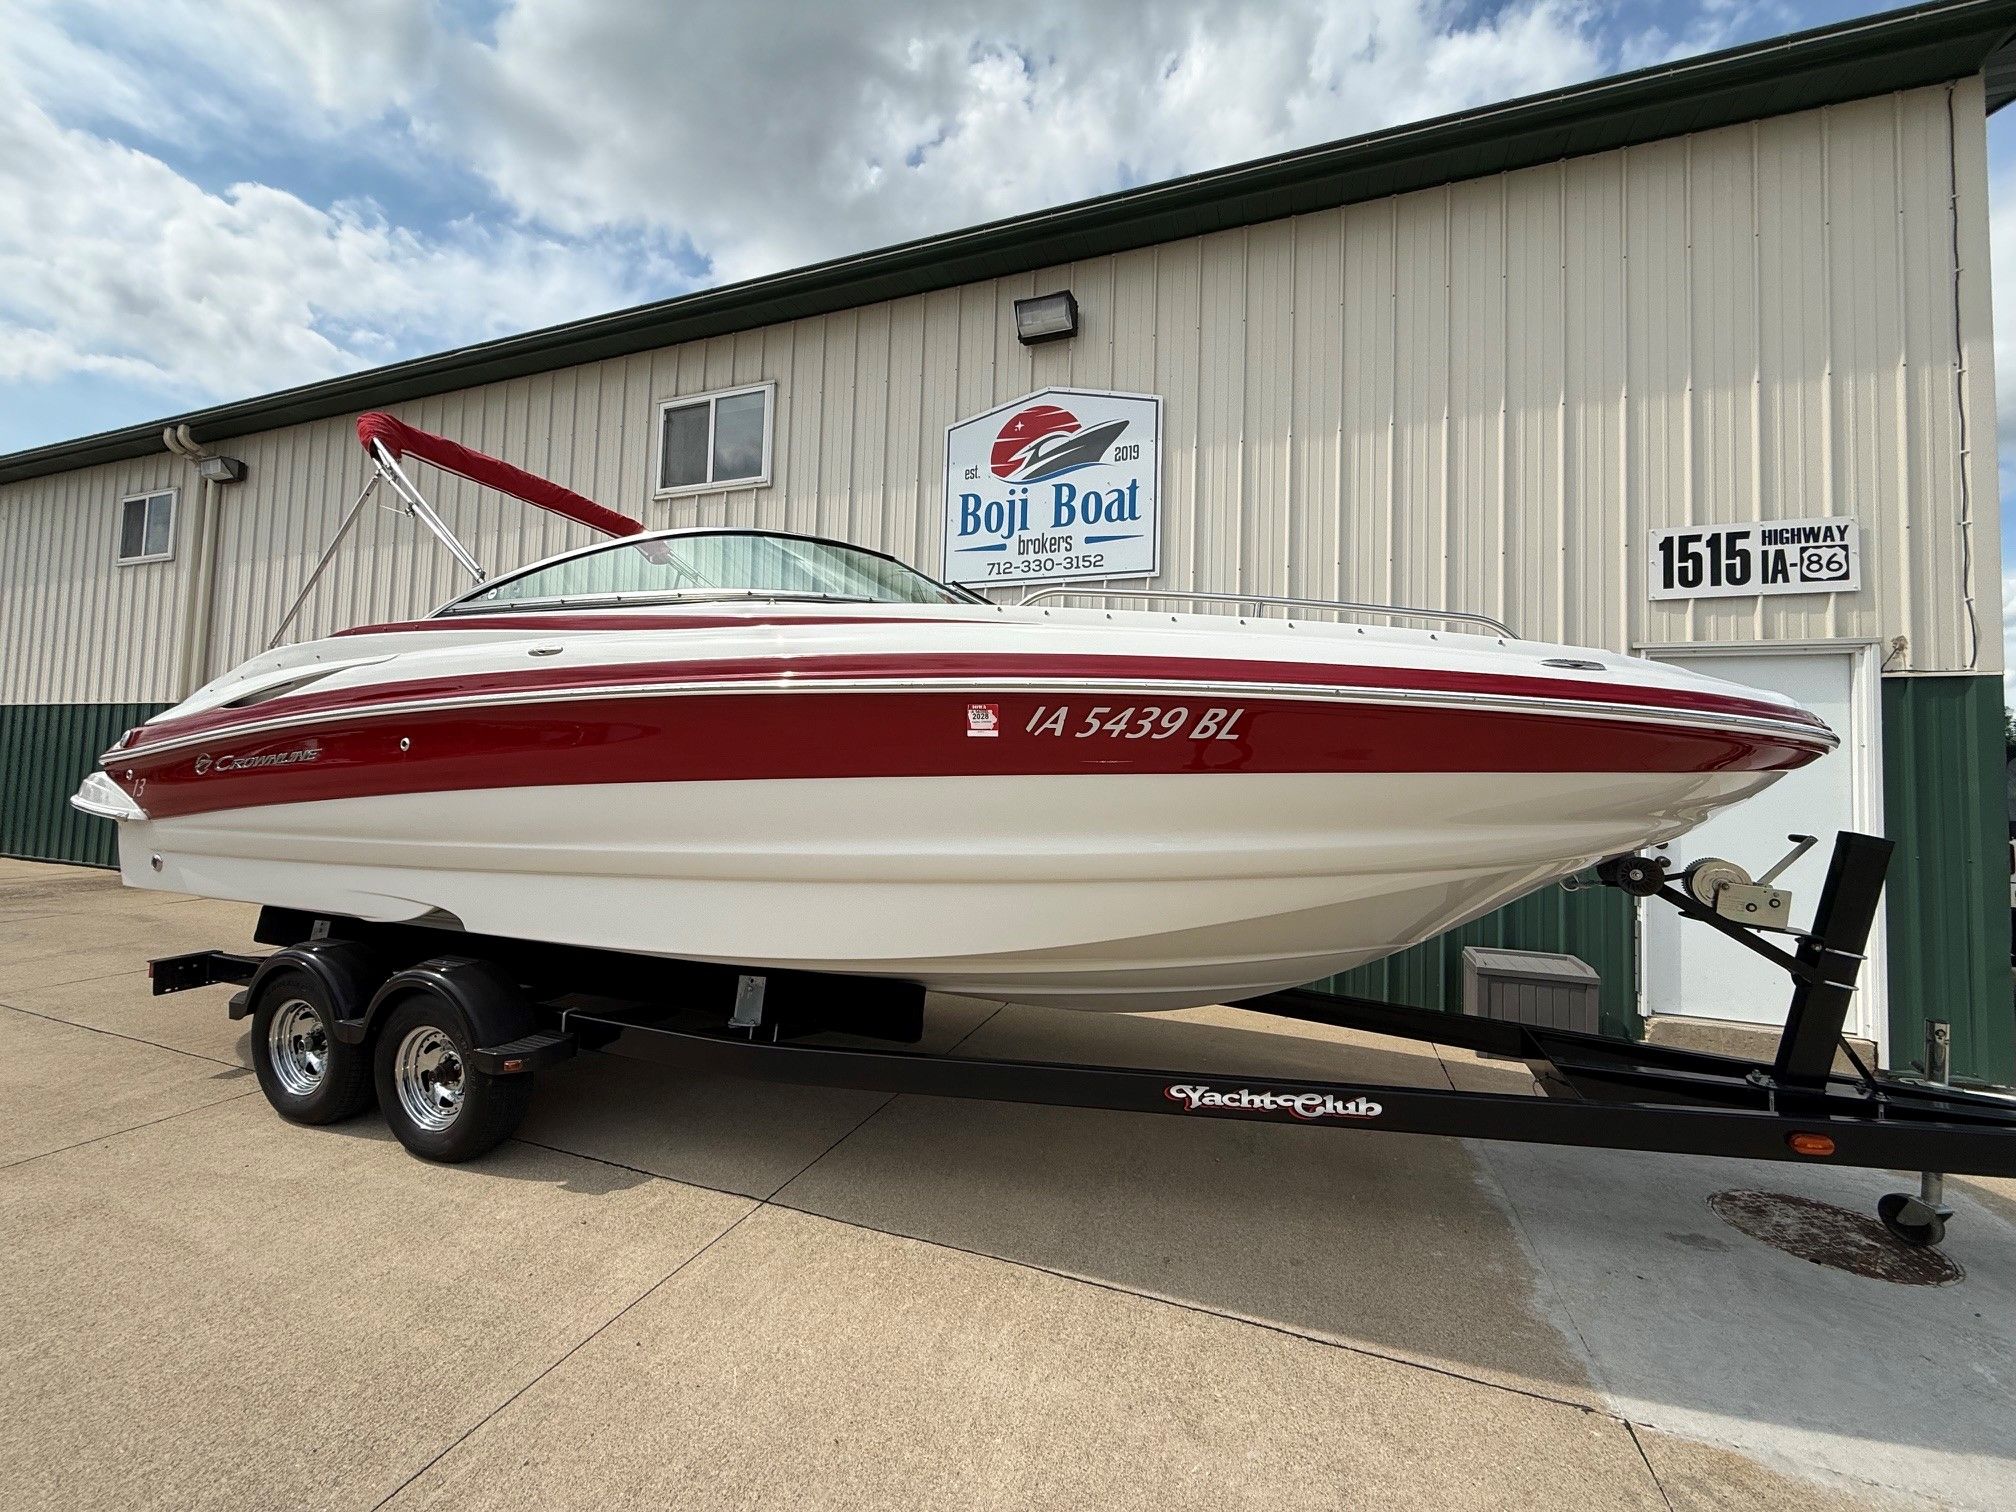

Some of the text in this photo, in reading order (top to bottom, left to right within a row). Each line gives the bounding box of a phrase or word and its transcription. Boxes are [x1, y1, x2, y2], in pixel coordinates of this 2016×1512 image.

[964, 444, 1140, 480] est. 2019
[957, 478, 1142, 540] Boji Boat
[1017, 532, 1073, 556] brokers
[1761, 524, 1849, 547] HIGHWAY
[986, 554, 1104, 576] 712-330-3152
[1658, 530, 1751, 590] 1515
[1025, 706, 1245, 740] IA 5439 BL
[214, 748, 323, 772] CROWNLINE
